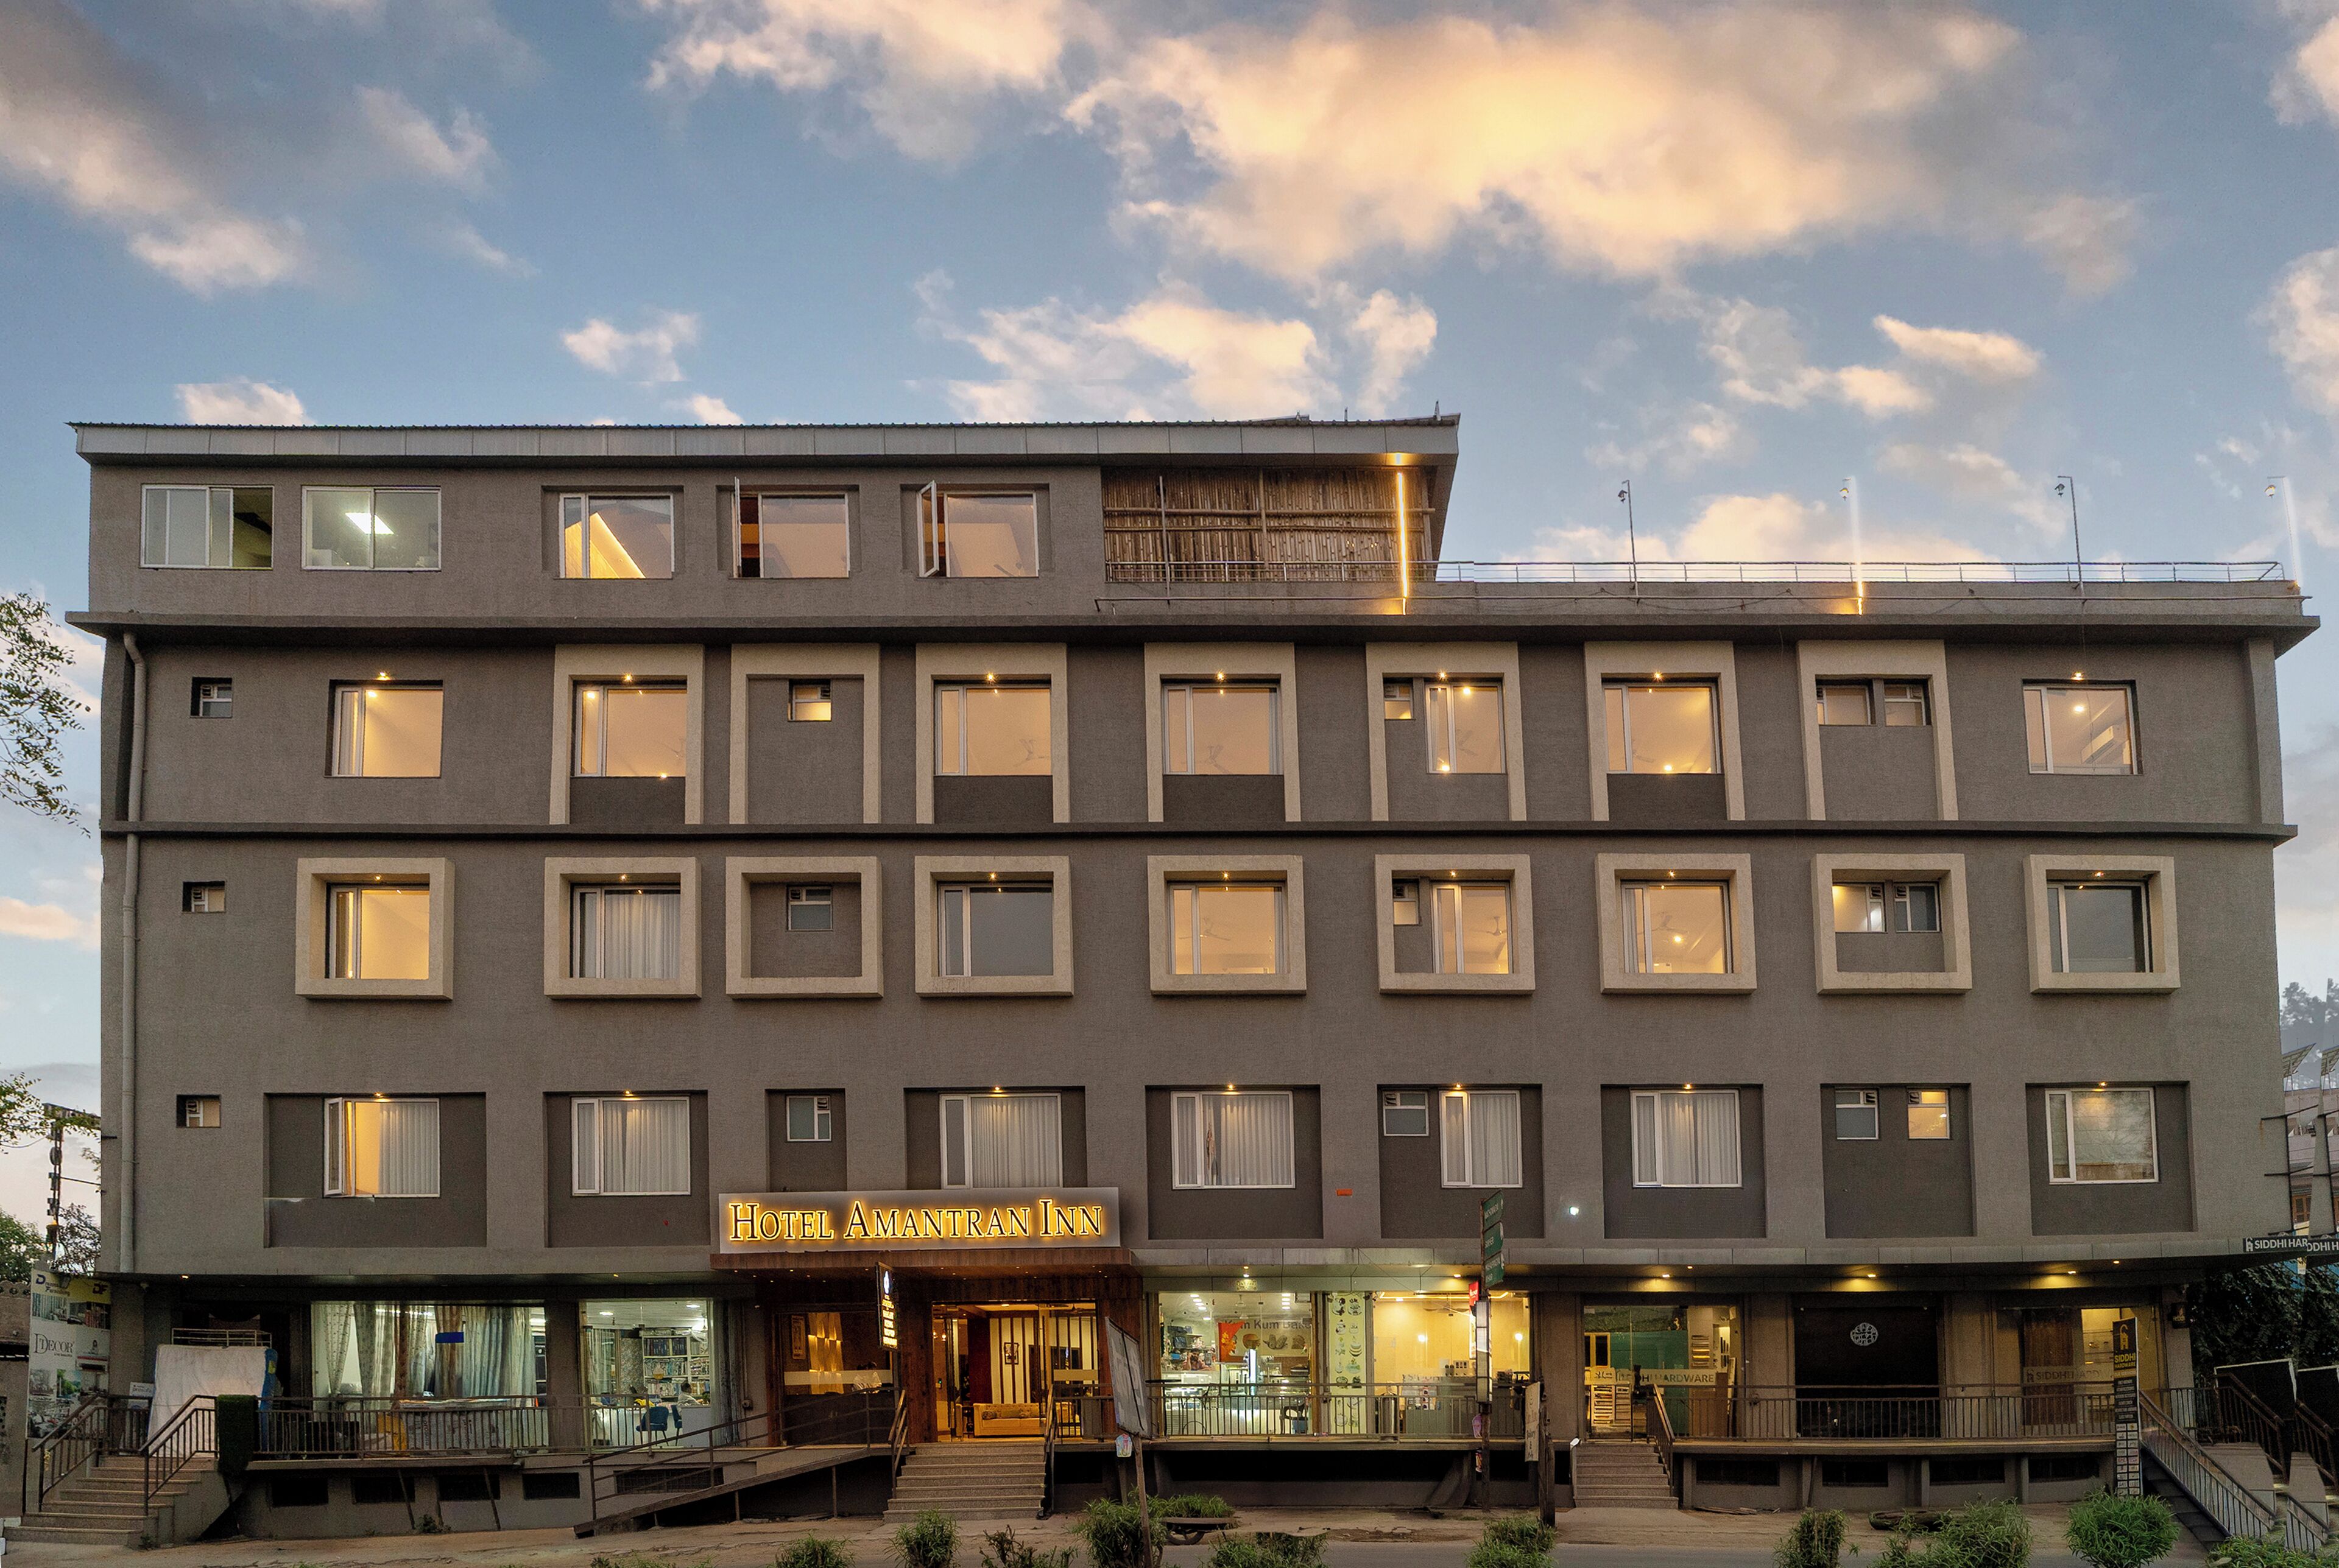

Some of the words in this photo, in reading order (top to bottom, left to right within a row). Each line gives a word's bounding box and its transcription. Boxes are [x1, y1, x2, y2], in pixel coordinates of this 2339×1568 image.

[729, 1202, 834, 1241] HOTEL
[844, 1200, 1031, 1239] AMANTRAN
[1039, 1198, 1102, 1237] INN
[2254, 1239, 2287, 1249] SIDDHI
[1254, 1320, 1279, 1329] Kum
[2114, 1352, 2136, 1363] SIDDHI
